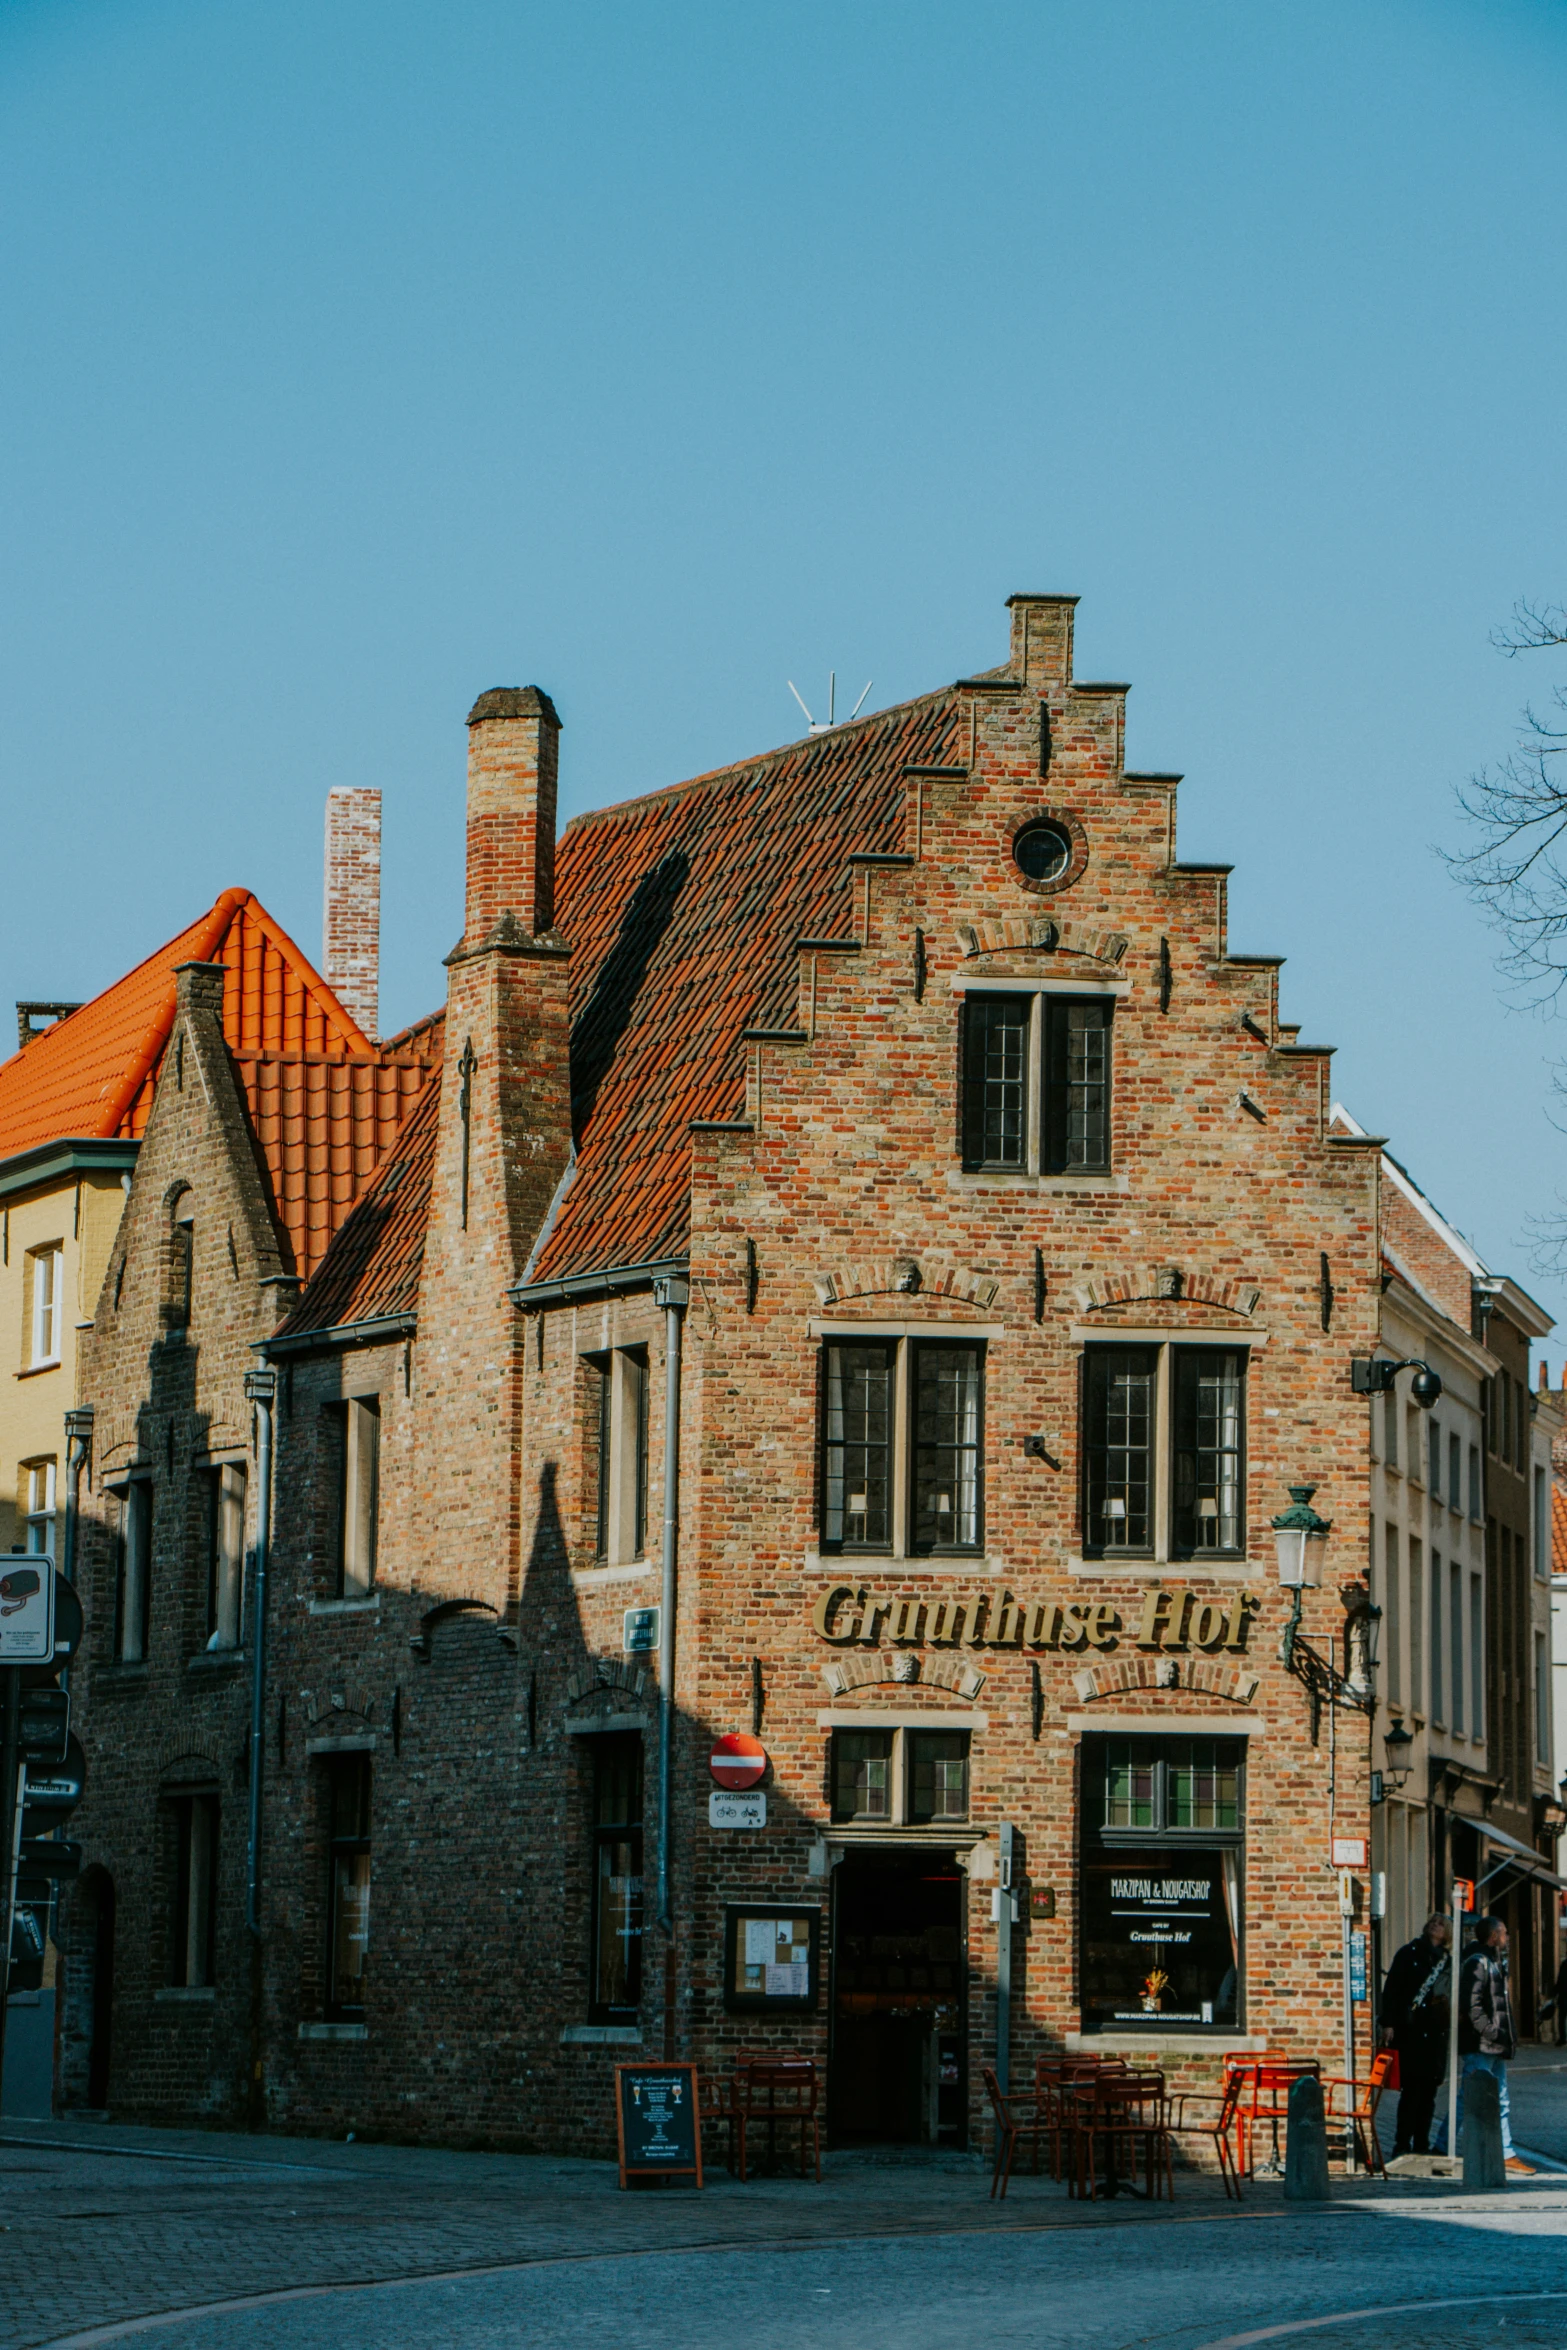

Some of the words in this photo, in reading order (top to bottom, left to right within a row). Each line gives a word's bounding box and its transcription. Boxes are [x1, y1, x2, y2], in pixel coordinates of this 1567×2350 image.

[812, 1585, 1116, 1646] Gruuthuse
[1136, 1588, 1254, 1647] Hof
[1110, 1878, 1151, 1898] MARZIPAN
[1152, 1882, 1161, 1898] &
[1161, 1879, 1211, 1900] NOUGATSHOP
[1130, 1930, 1173, 1942] Gruuthuse
[1174, 1931, 1192, 1942] Hof
